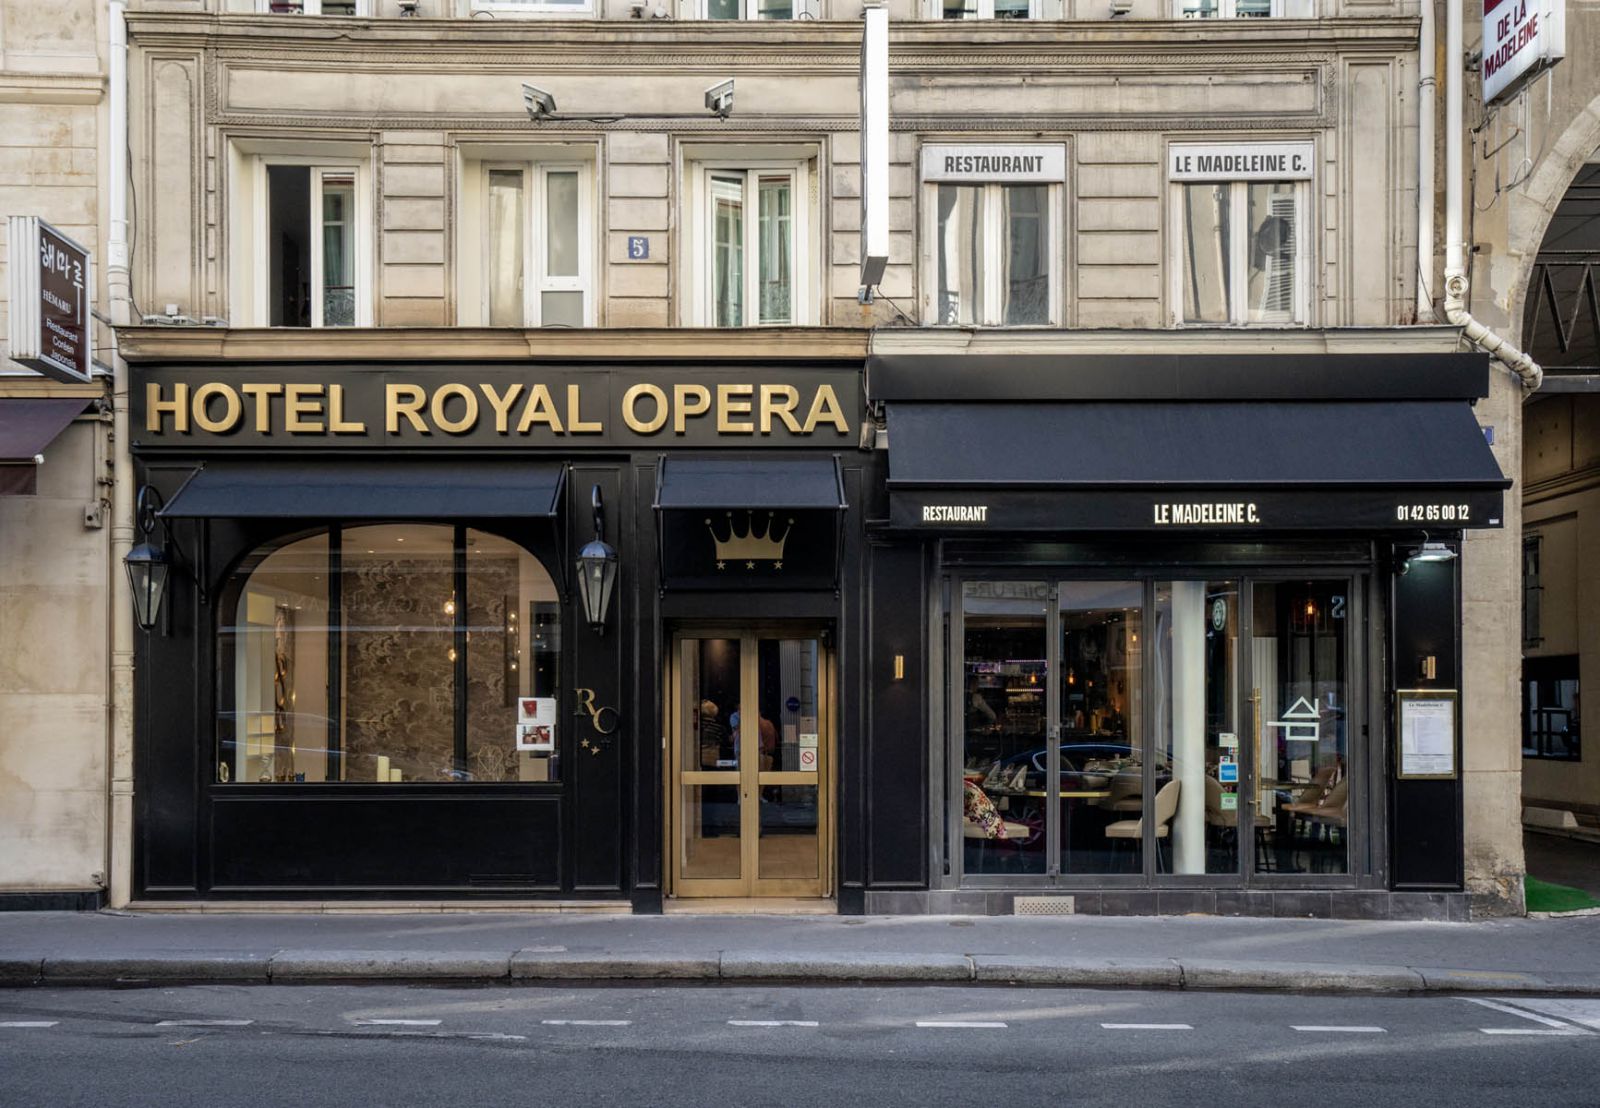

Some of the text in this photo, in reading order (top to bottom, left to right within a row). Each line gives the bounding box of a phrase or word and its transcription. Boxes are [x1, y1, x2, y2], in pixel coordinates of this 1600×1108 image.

[1498, 0, 1527, 42] DE LA
[1485, 13, 1538, 80] MADELEINE
[944, 155, 1044, 173] RESTAURANT
[1175, 154, 1307, 173] LE MADELEINE C.
[633, 239, 644, 257] 5
[46, 317, 79, 344] Restaurant
[146, 382, 850, 433] HOTEL ROYAL OPERA
[923, 503, 1469, 523] RESTAURANT LE MADELEINE C. 01 42 65 00 12
